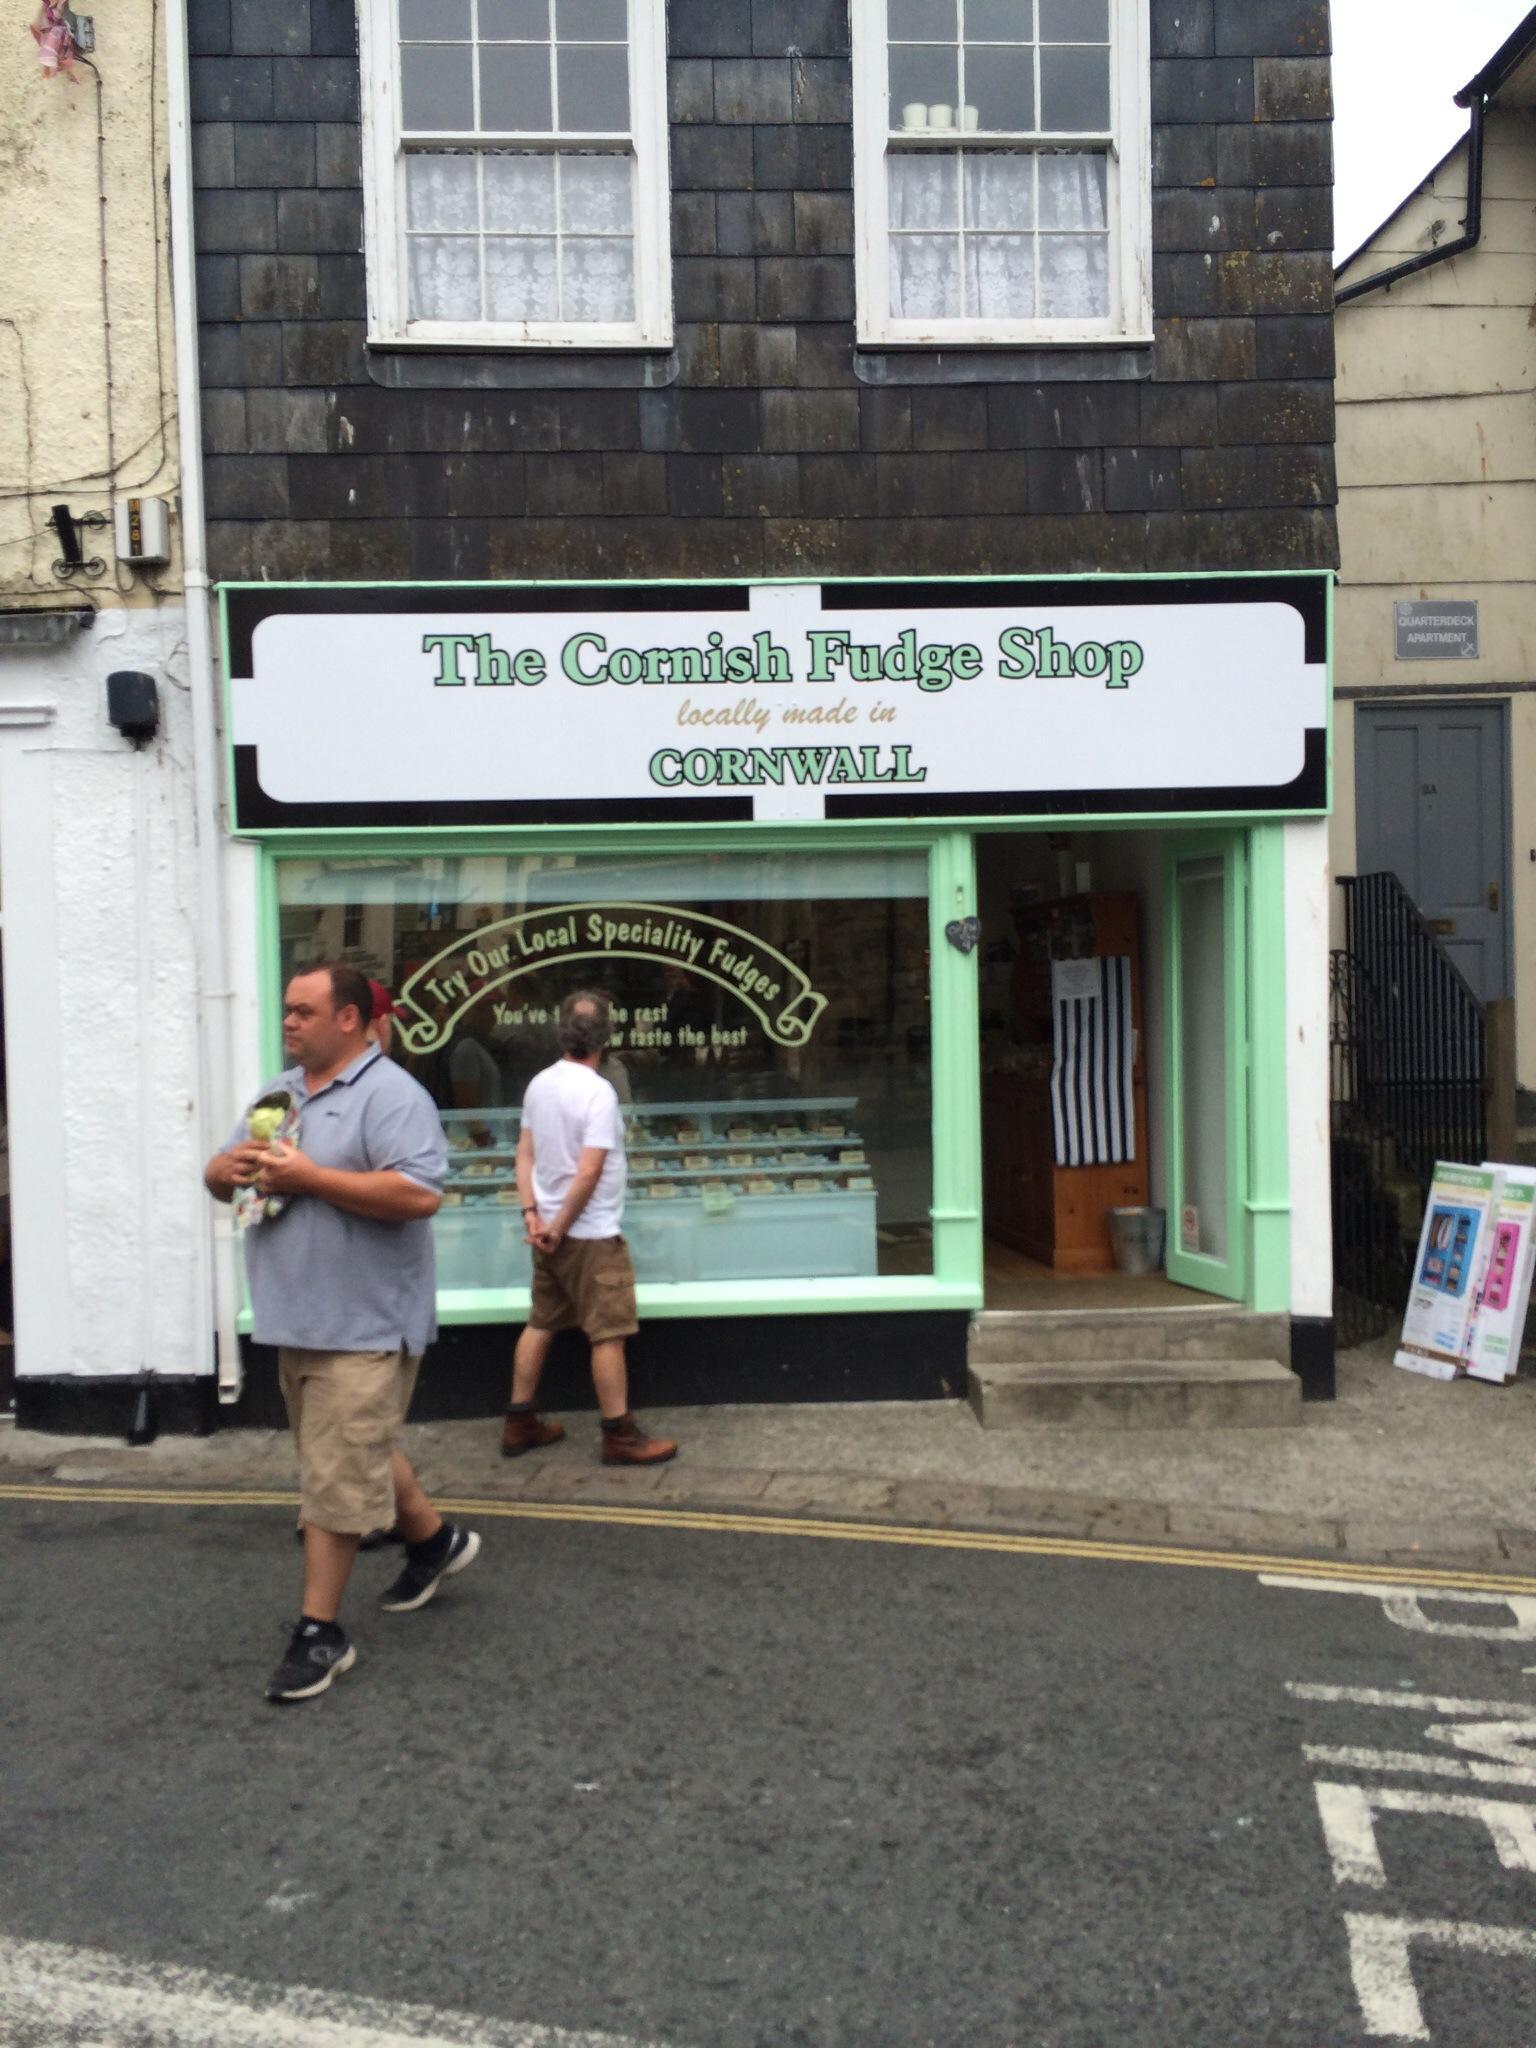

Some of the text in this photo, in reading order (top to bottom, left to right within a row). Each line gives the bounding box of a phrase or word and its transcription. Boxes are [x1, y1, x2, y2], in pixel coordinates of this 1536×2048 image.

[1399, 615, 1475, 627] QUARTERDECK
[1407, 632, 1467, 643] APARTMENT
[422, 626, 1144, 692] The Cornish Fudge Shop
[676, 697, 898, 734] locally made in
[649, 745, 927, 786] CORNWALL
[424, 913, 781, 1004] Try Our Local Speciality Fudges
[492, 1001, 548, 1026] You've
[609, 1001, 629, 1022] he
[629, 1026, 673, 1047] taste
[678, 1023, 706, 1046] the
[711, 1023, 748, 1046] best
